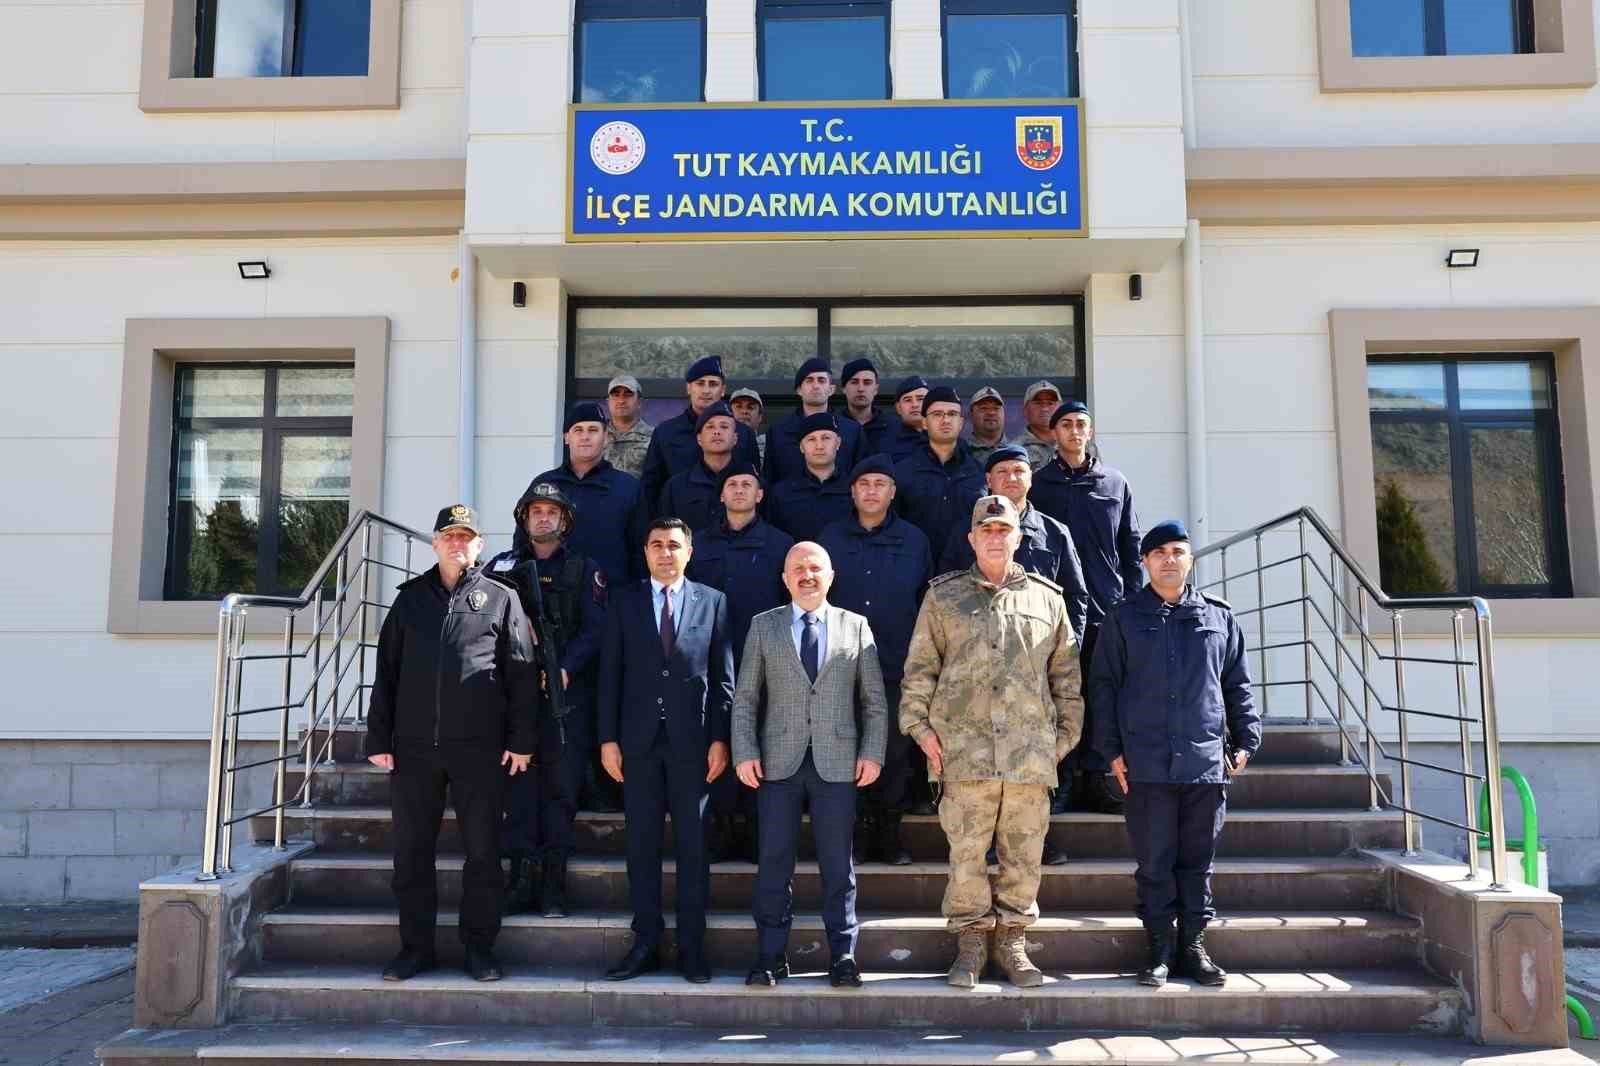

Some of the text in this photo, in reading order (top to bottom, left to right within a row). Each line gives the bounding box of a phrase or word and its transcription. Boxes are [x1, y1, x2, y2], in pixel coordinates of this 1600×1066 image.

[800, 118, 853, 143] T.C.
[673, 143, 982, 178] TUT KAYMAKAMLIĞI
[586, 182, 1068, 226] İLÇE JANDARMA KOMUTANLIĞI
